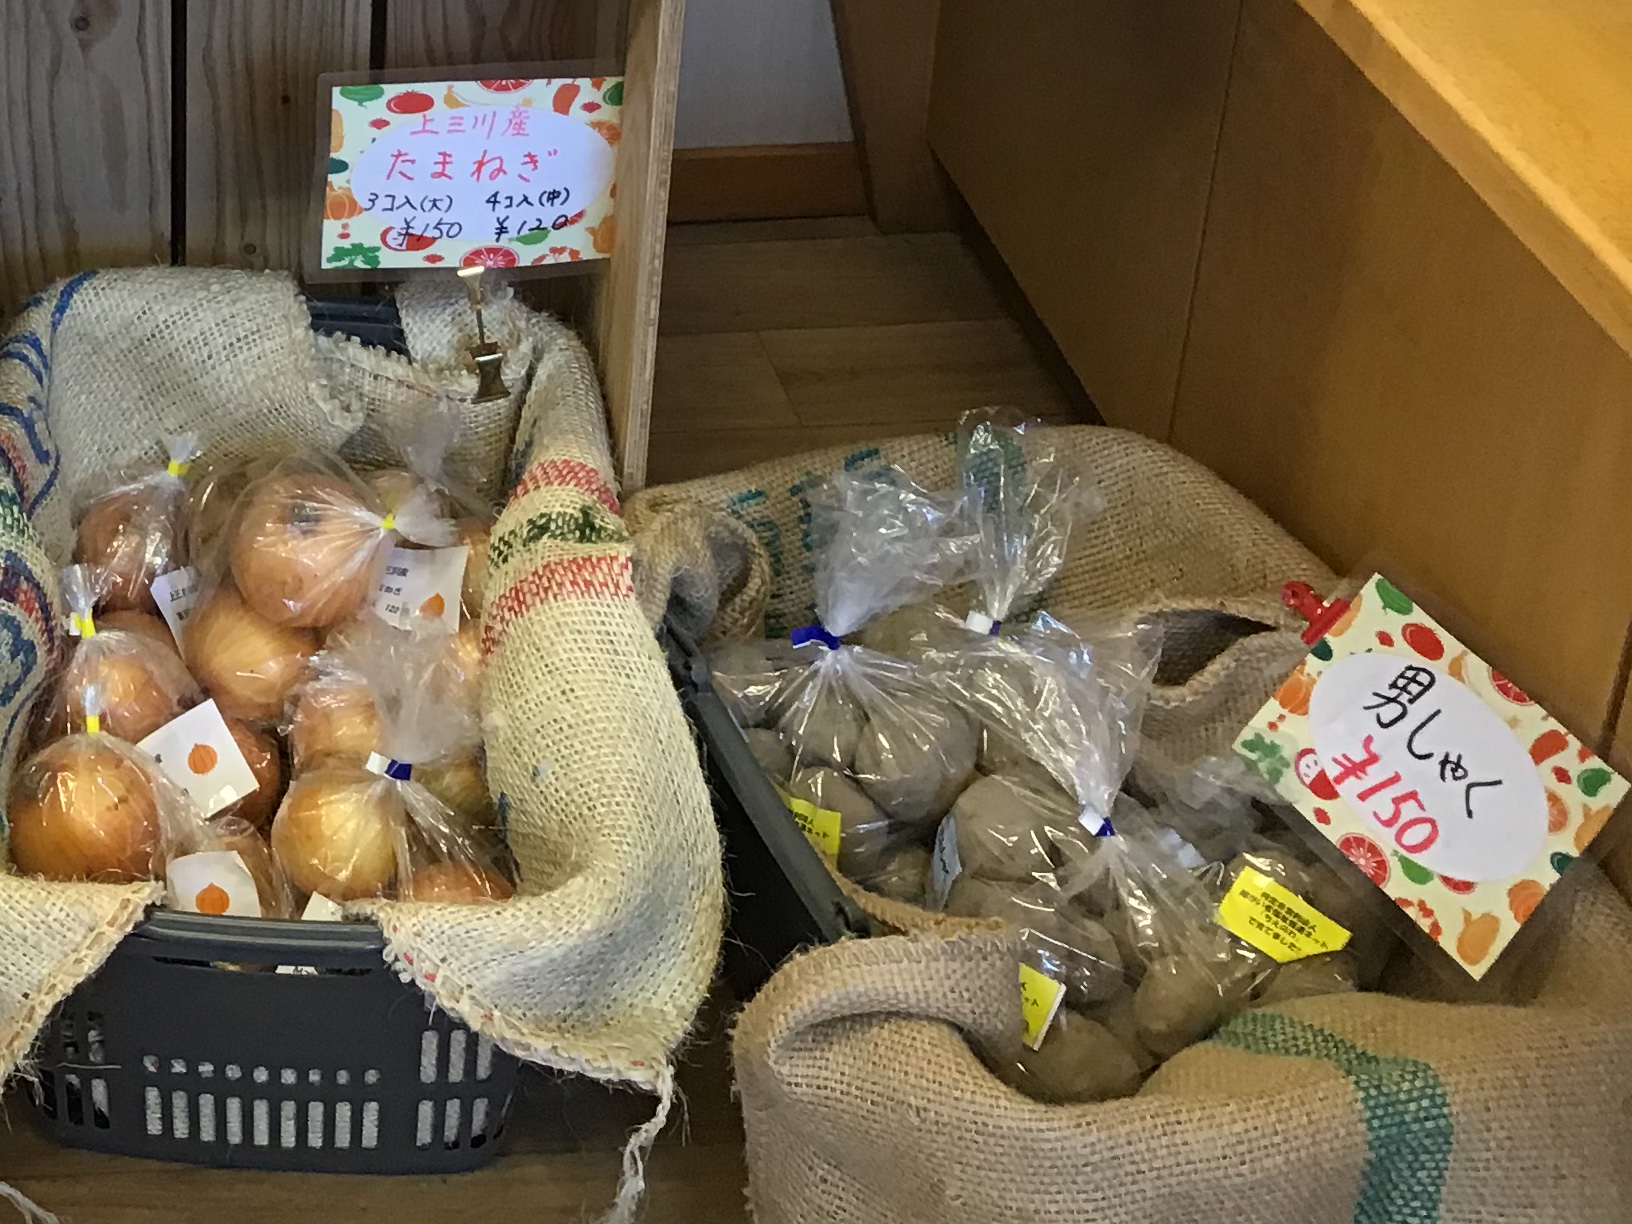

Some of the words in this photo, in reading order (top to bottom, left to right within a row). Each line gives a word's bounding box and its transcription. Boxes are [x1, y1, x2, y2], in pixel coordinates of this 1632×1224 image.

[409, 106, 531, 140] 上三川産
[385, 148, 559, 184] たまねぎ
[395, 215, 463, 248] ¥150
[1362, 664, 1503, 819] 男しゃく
[1331, 733, 1439, 854] ¥150
